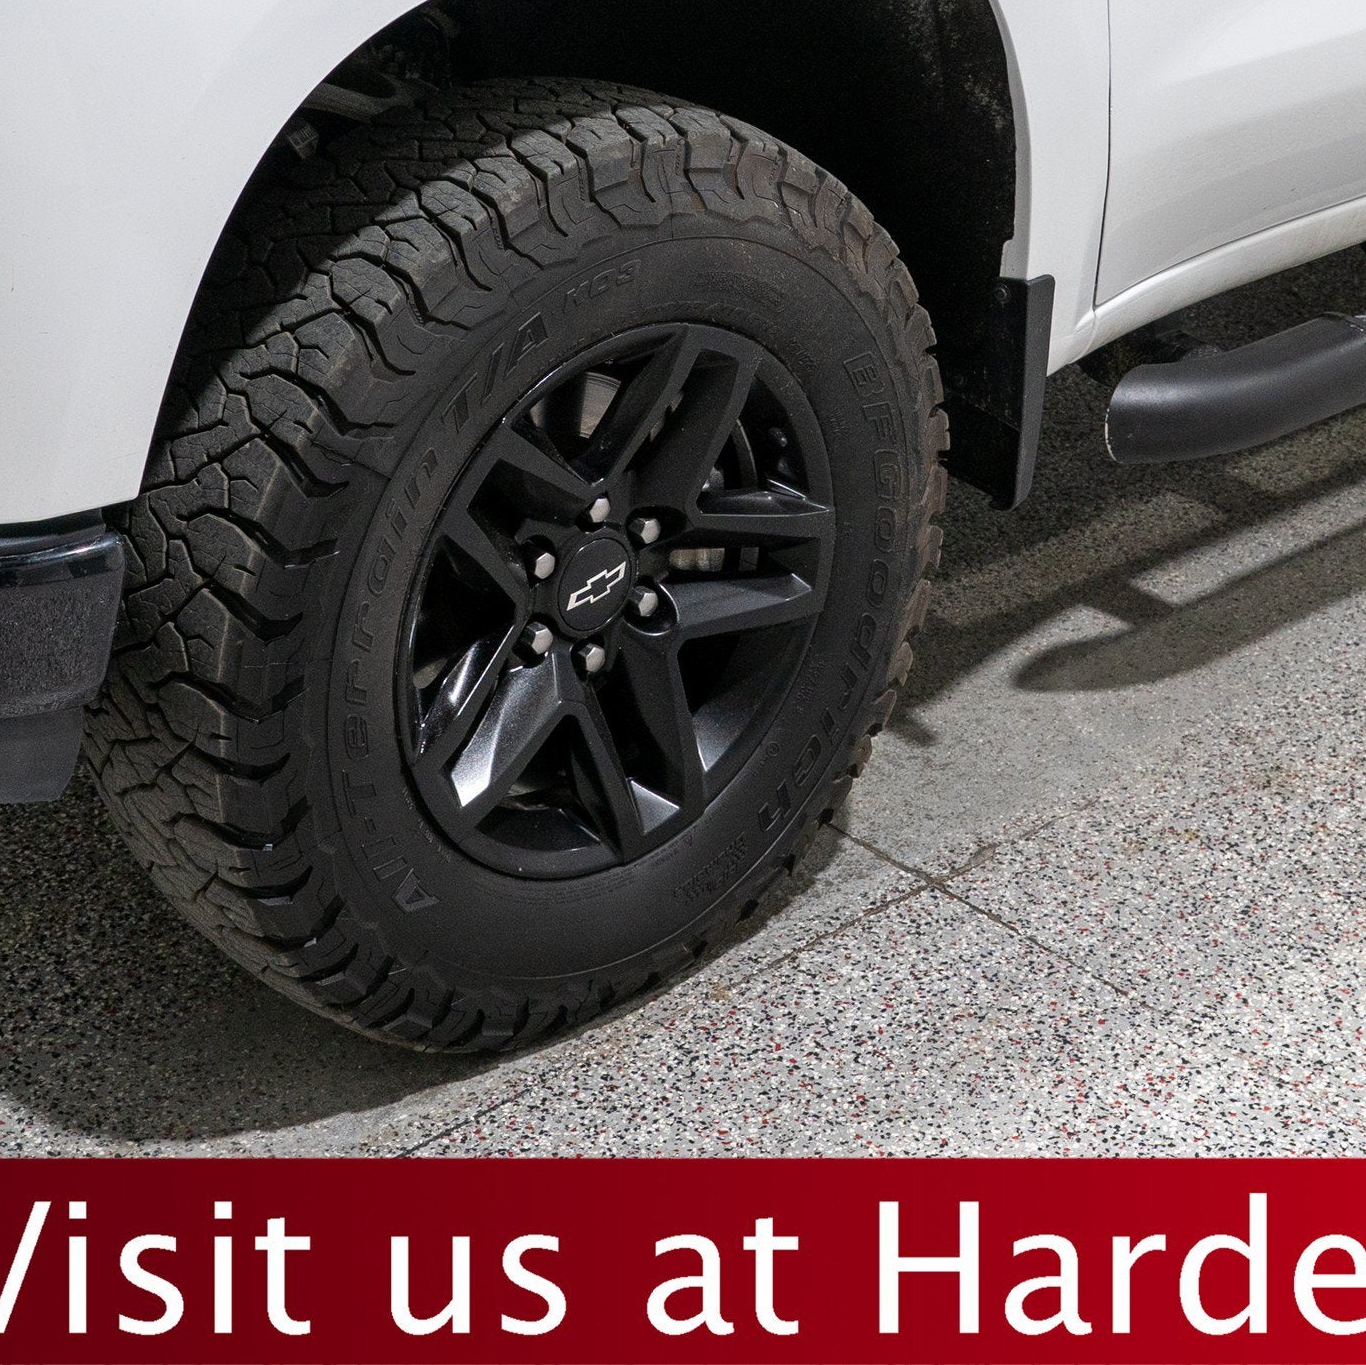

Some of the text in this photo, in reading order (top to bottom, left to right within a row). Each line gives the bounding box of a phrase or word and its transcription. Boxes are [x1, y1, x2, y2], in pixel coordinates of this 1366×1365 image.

[341, 447, 439, 915] All-Terrain
[441, 311, 549, 435] T/A
[757, 351, 905, 833] BFGoodrich
